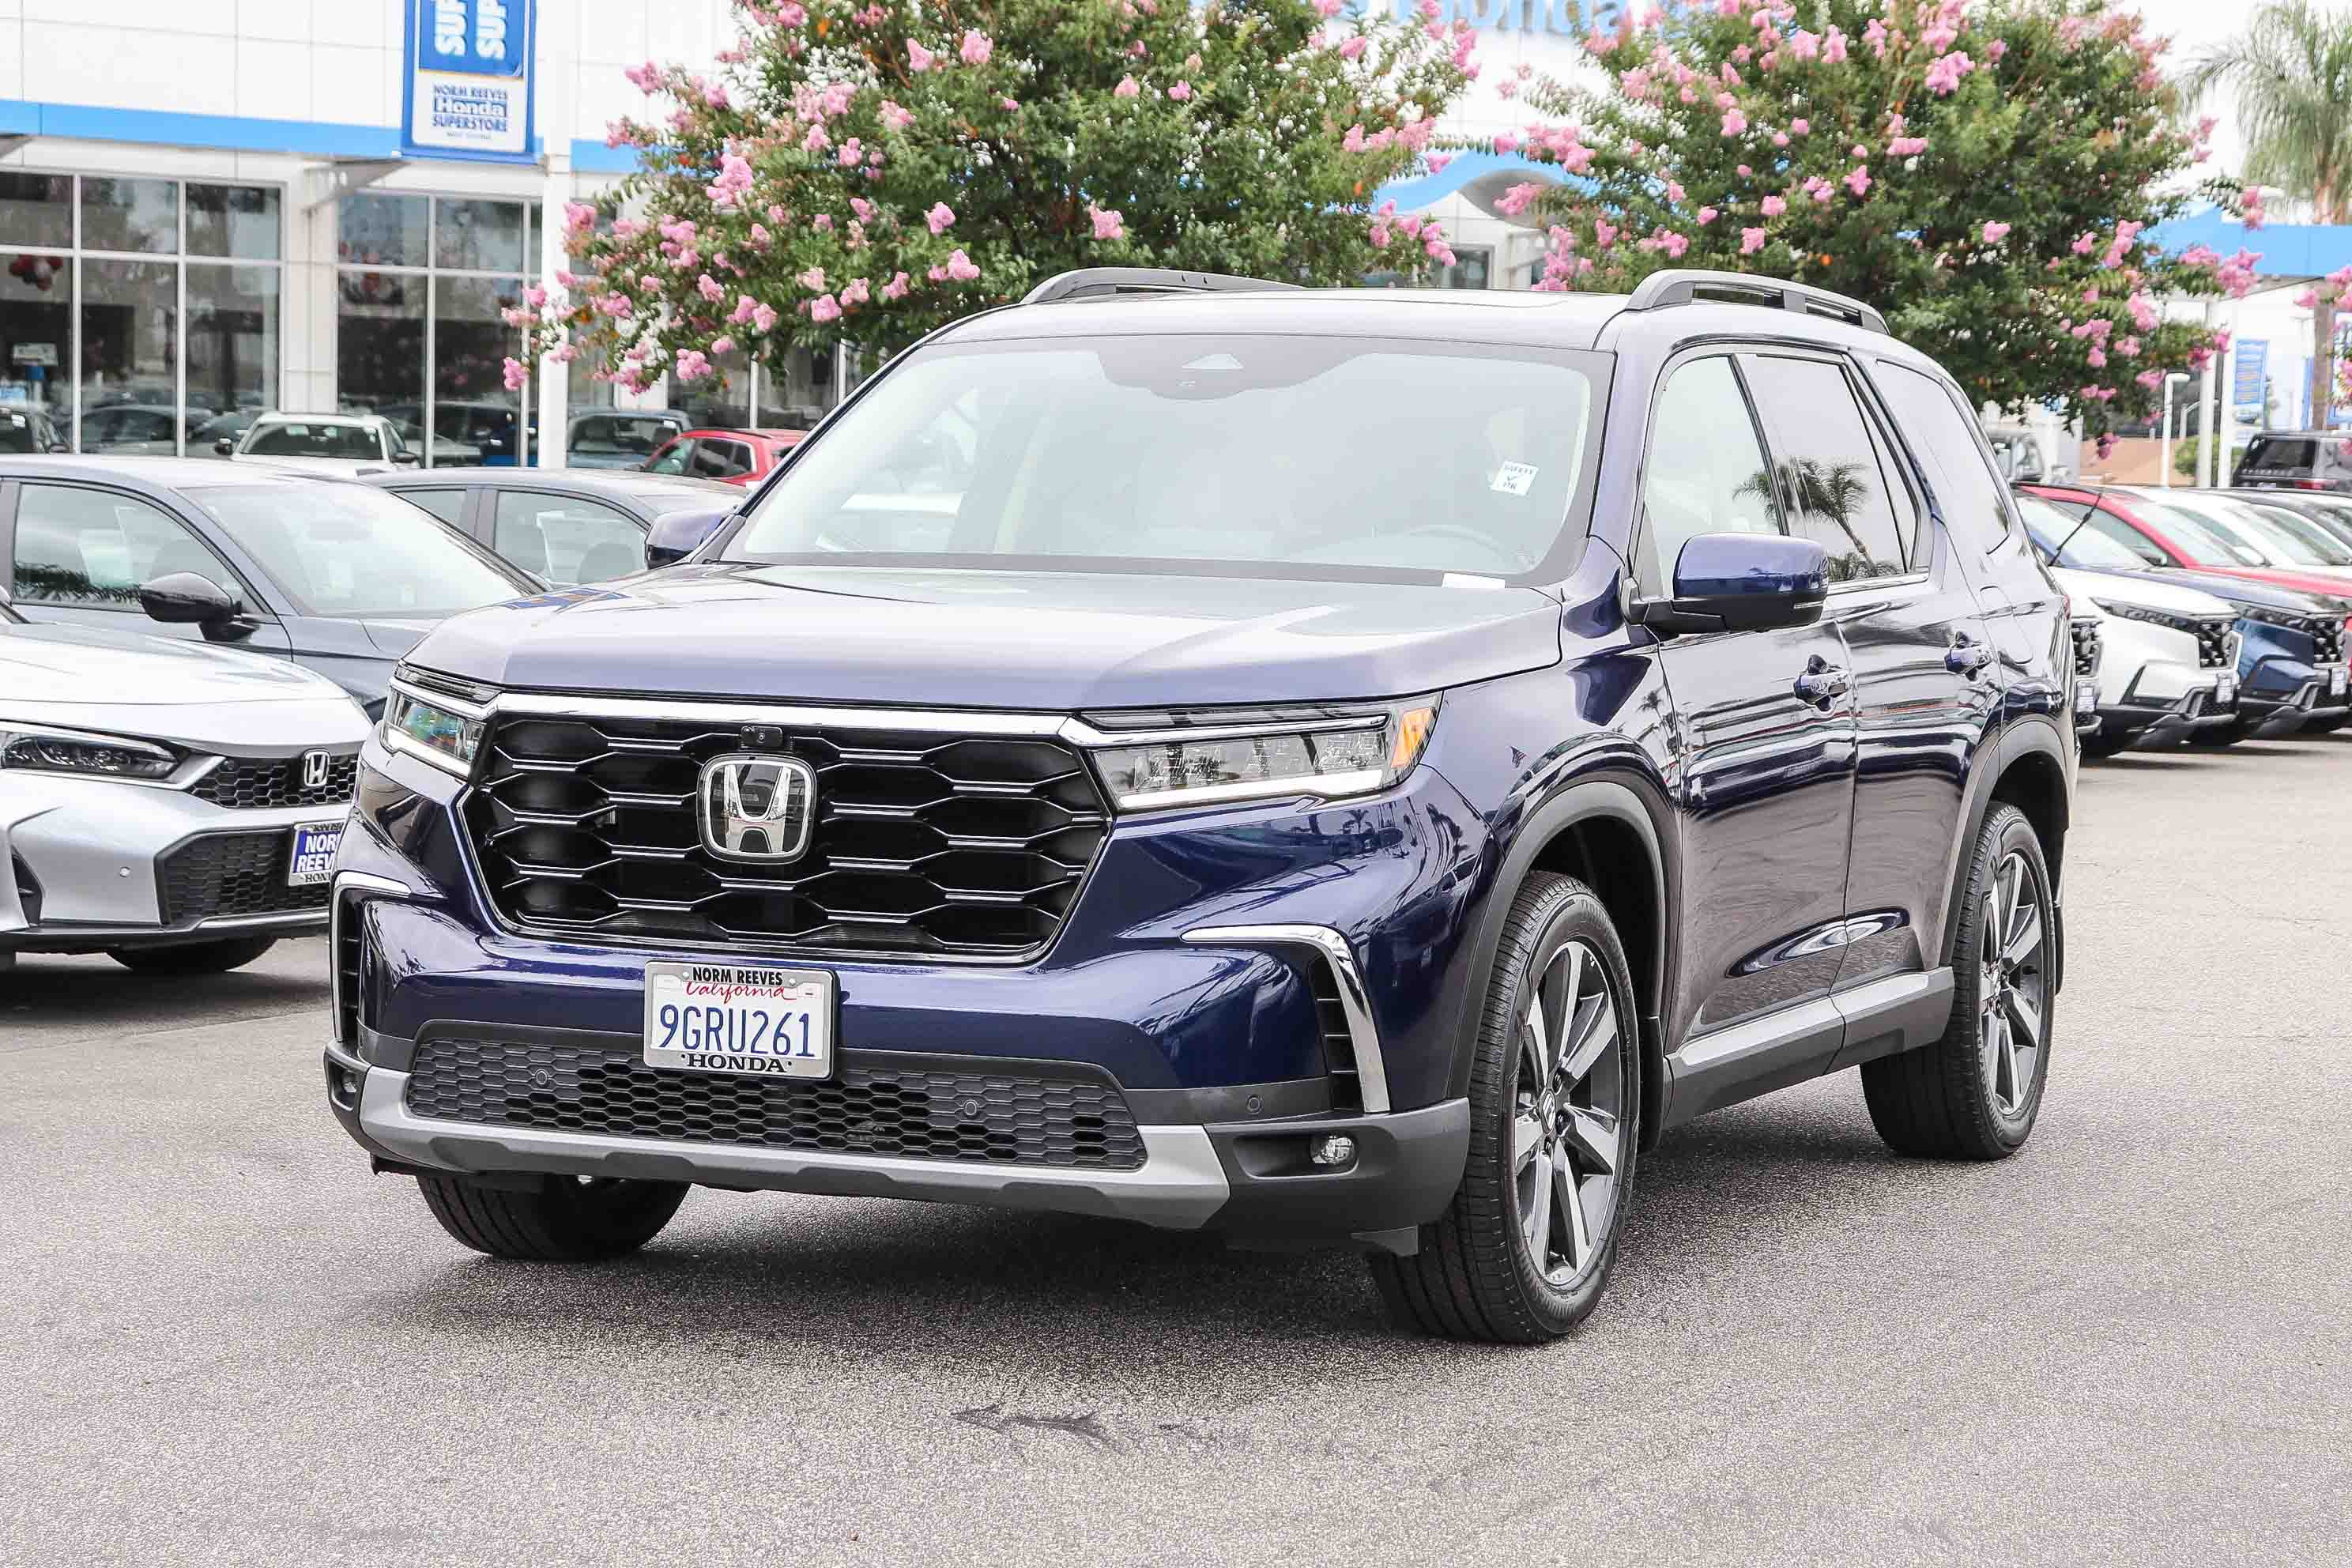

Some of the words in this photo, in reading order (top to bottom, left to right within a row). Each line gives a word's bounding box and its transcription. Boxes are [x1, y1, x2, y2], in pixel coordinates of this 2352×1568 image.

[435, 97, 506, 116] Honda
[432, 115, 507, 132] SUPERSTORE
[692, 967, 732, 983] NORM
[737, 971, 783, 986] REEVES
[685, 980, 797, 1004] California
[659, 1004, 815, 1057] 9GRU261
[687, 1053, 787, 1073] HONDA
